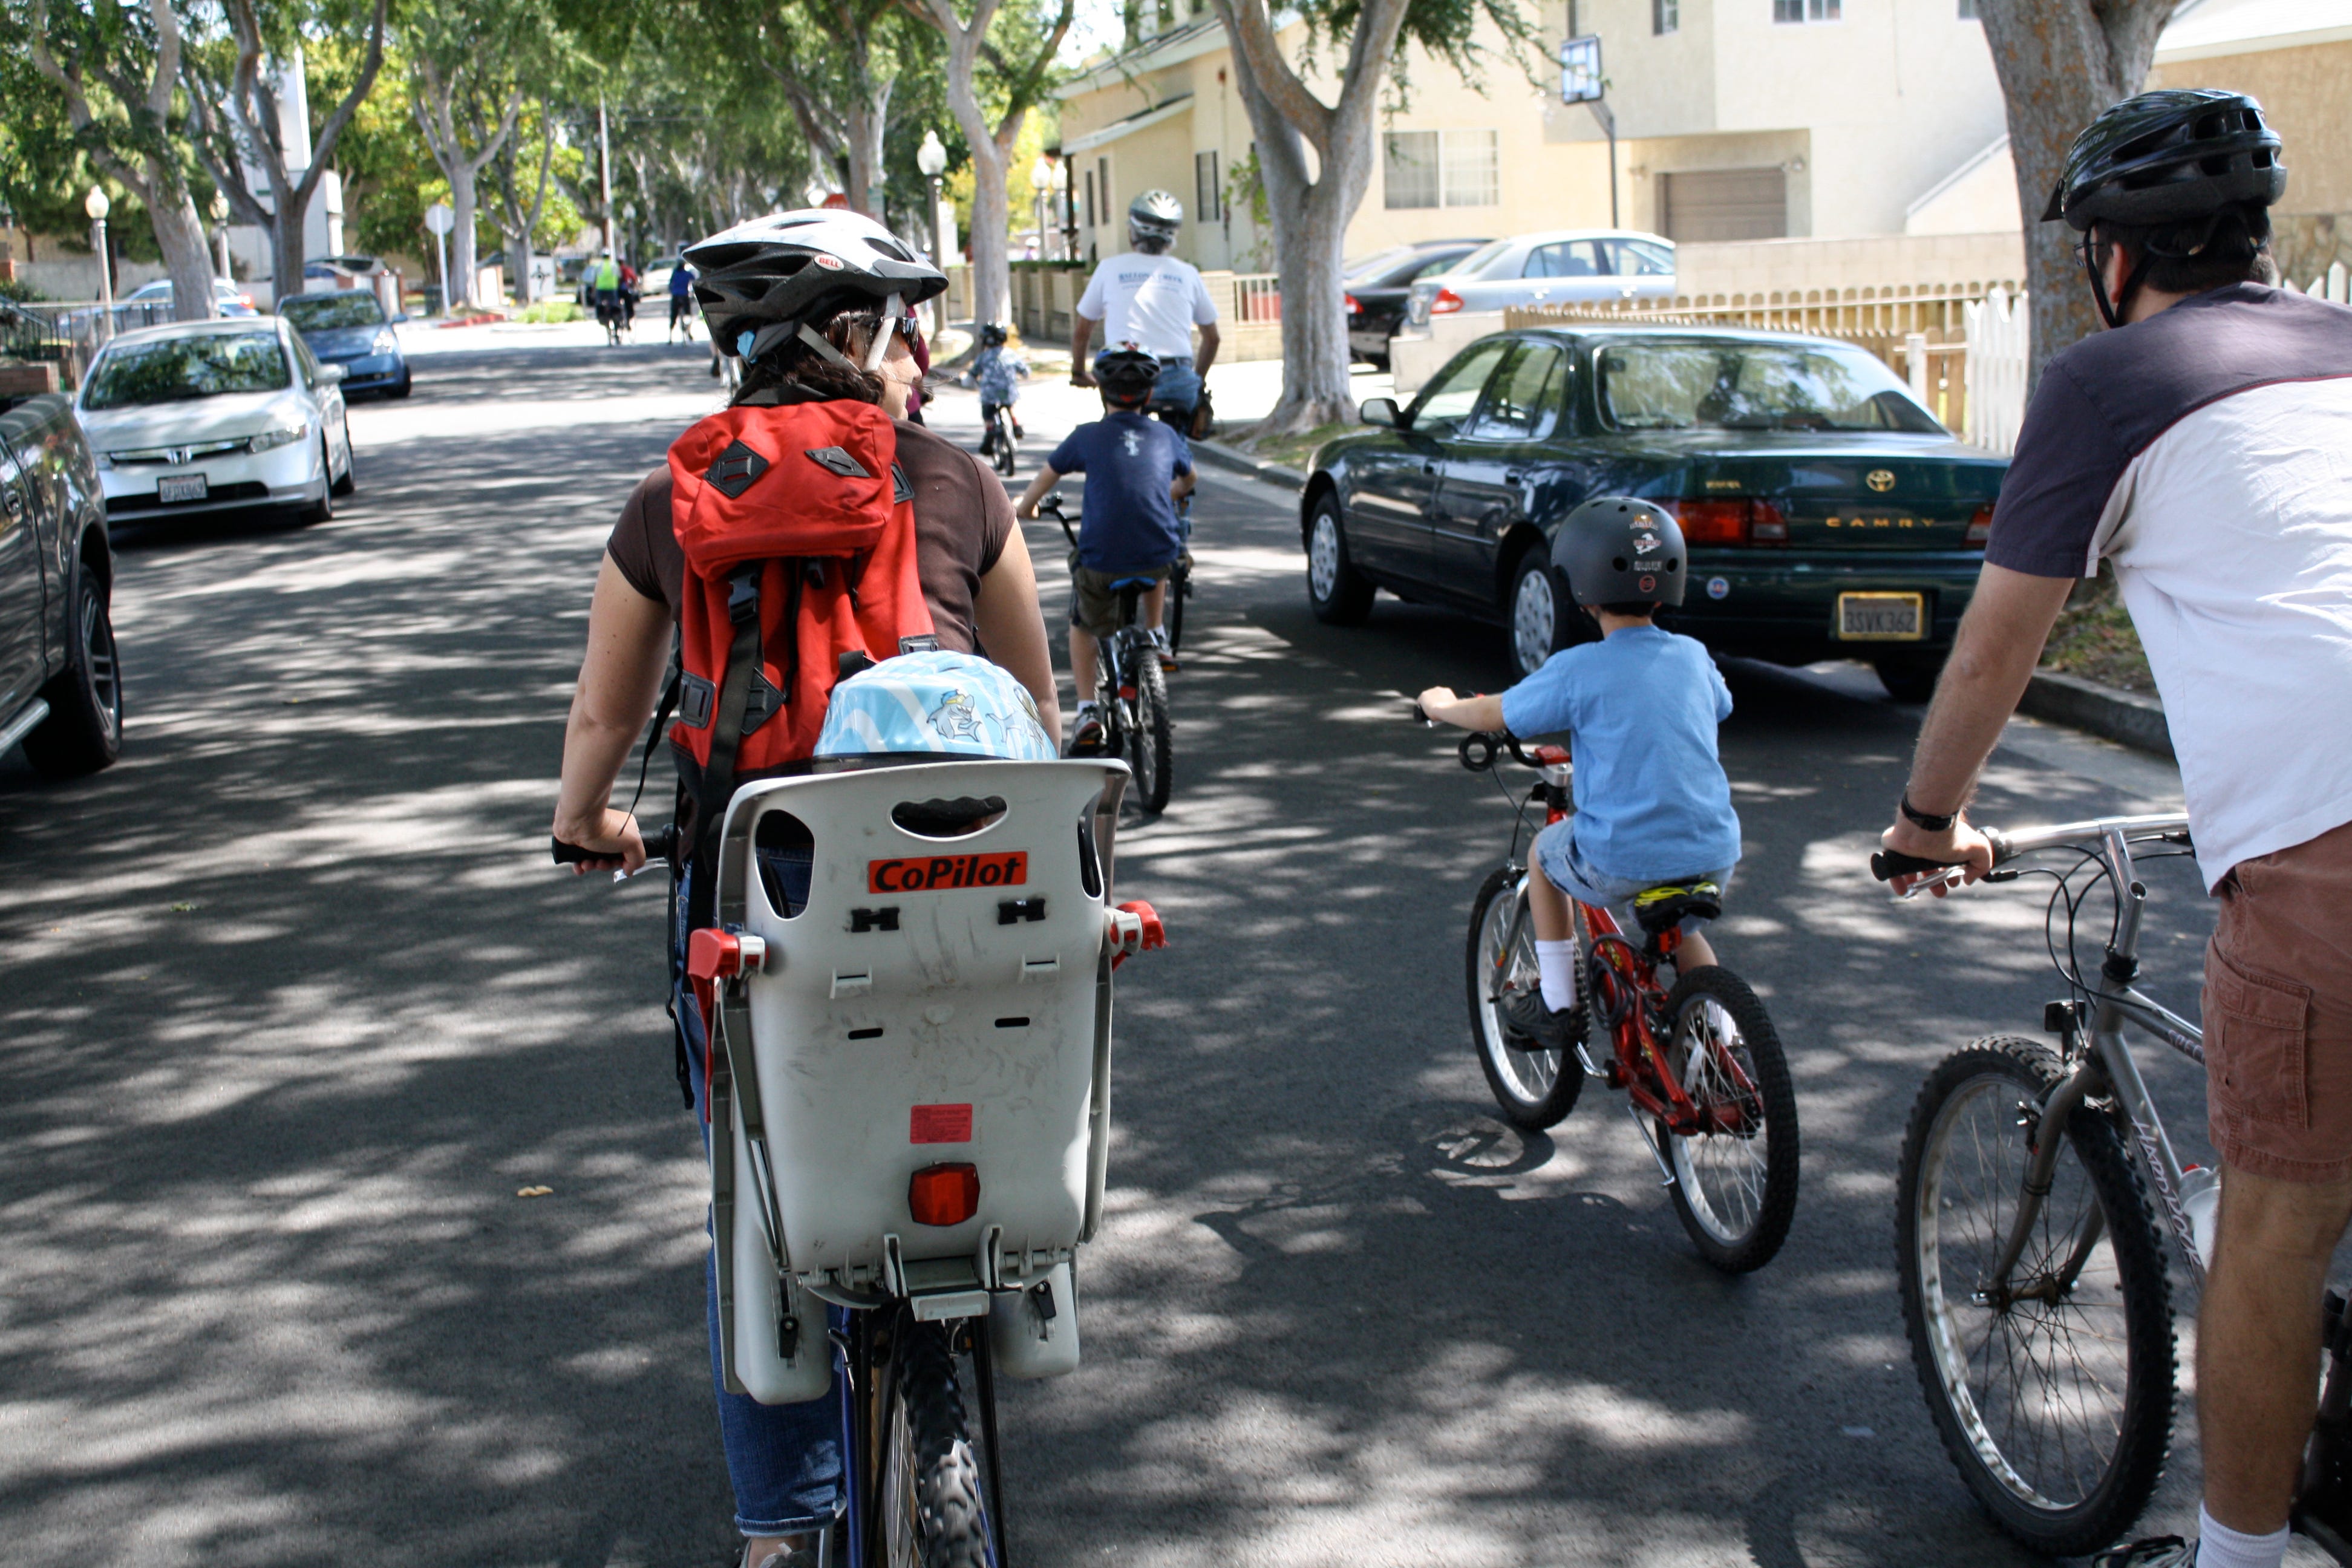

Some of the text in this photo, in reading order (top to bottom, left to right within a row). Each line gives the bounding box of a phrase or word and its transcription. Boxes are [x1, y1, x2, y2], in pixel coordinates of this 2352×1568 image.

[819, 257, 838, 268] BELL
[1826, 517, 1935, 528] CAMRY
[1844, 611, 1916, 633] 3SVK362
[875, 857, 1021, 891] CoPilot
